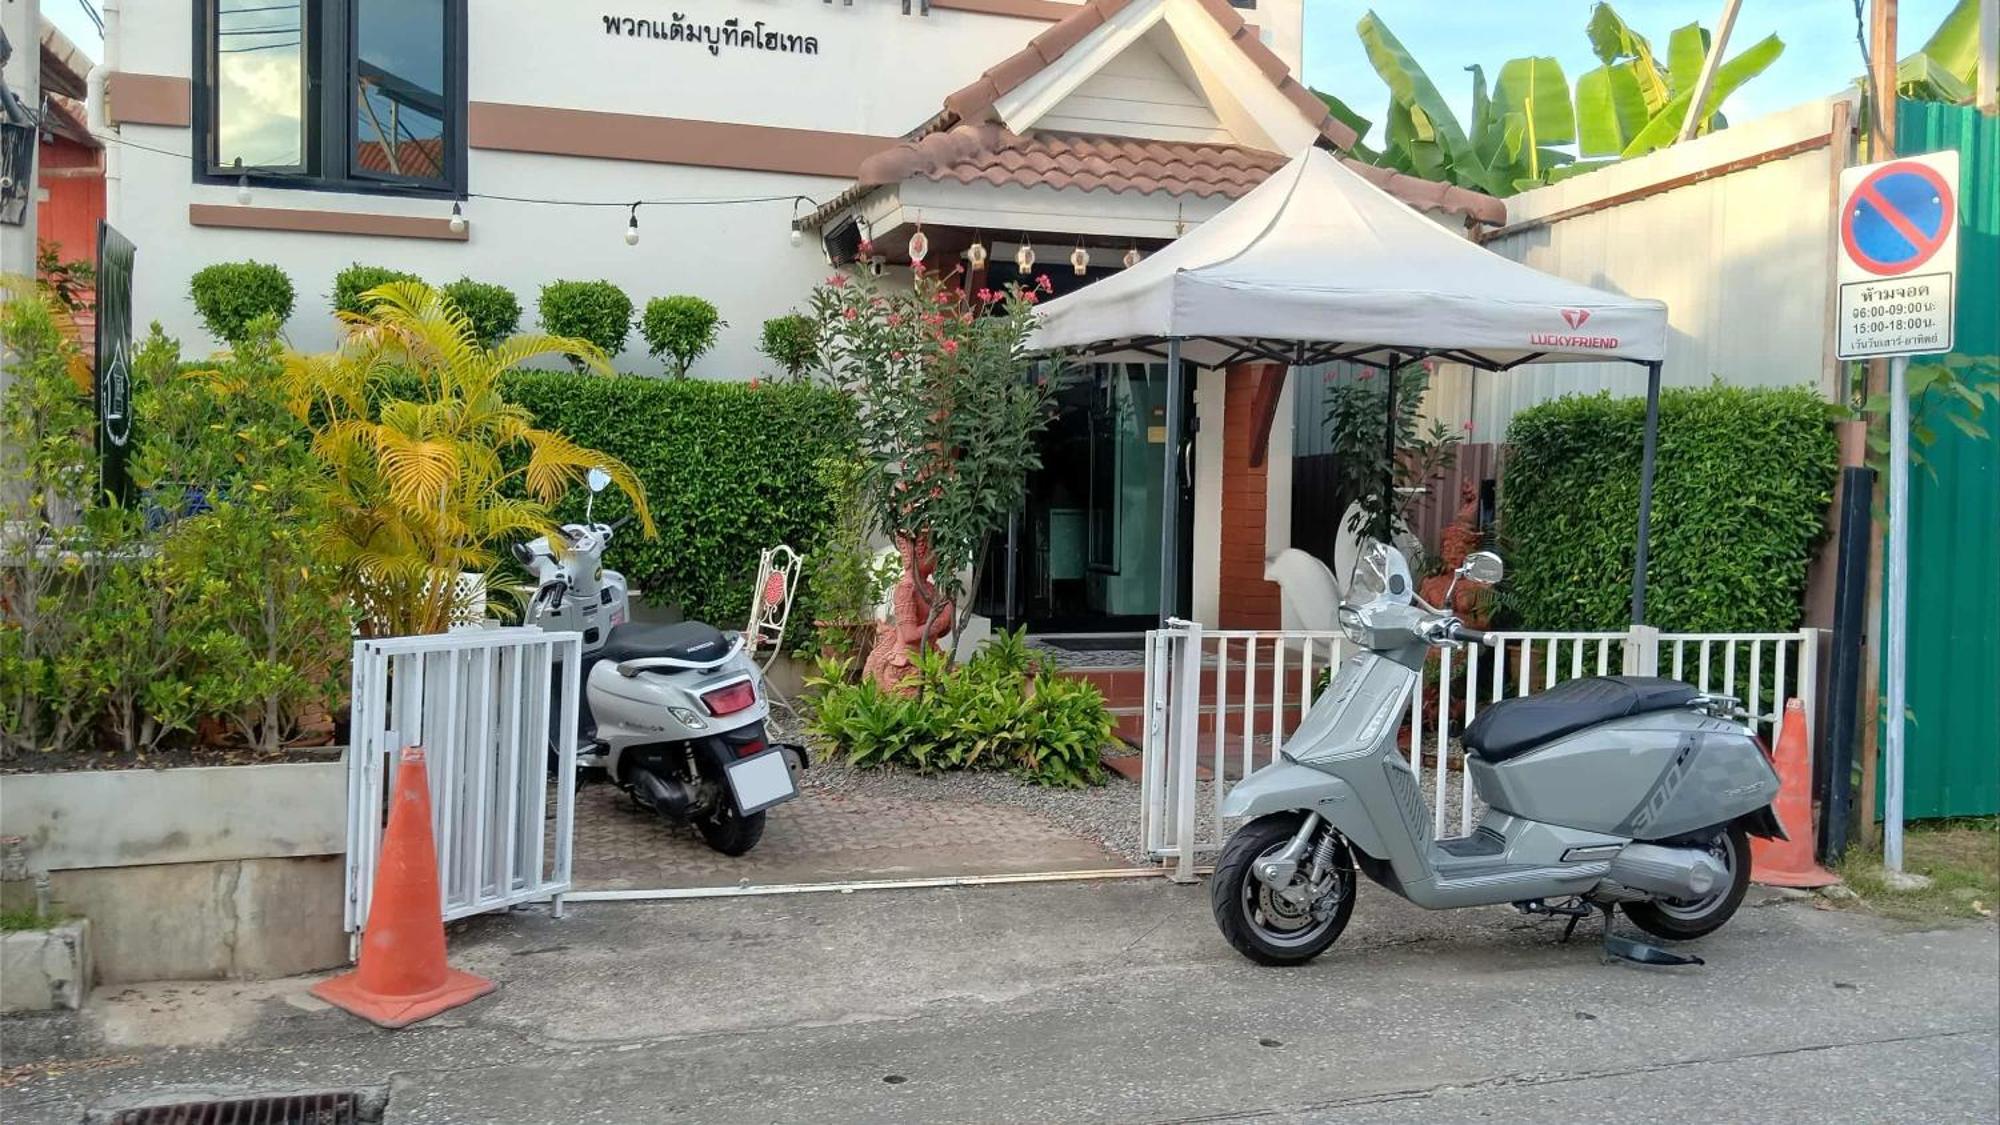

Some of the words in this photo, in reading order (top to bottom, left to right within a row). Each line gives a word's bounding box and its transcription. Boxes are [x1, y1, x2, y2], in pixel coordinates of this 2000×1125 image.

[603, 12, 819, 56] พวกแต้มบูทีคโฮเทล
[1861, 285, 1930, 302] ห้ามจอด
[1531, 334, 1618, 349] LUCKYFRIEND
